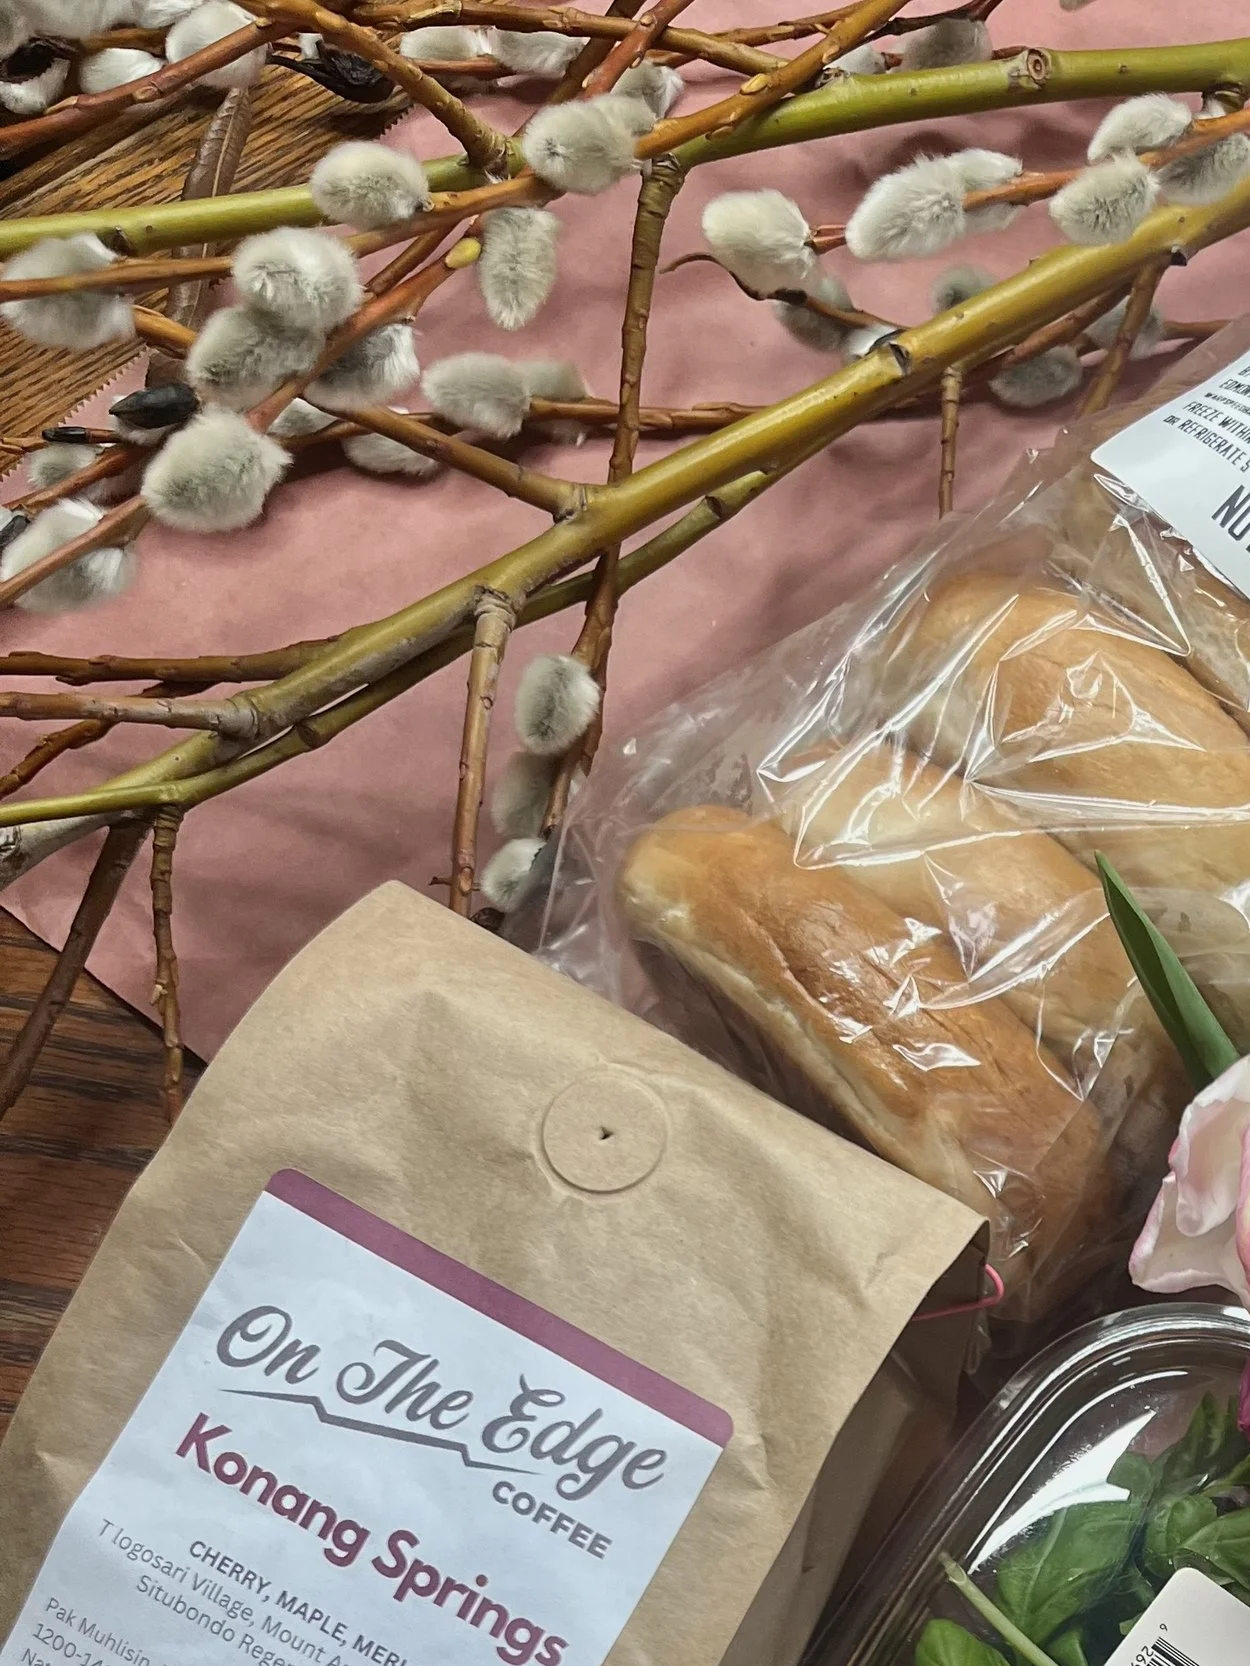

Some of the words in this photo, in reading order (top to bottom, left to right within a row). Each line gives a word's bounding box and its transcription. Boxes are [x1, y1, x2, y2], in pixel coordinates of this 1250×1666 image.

[1163, 414, 1179, 426] OR
[1177, 419, 1249, 465] REFRIGERATE
[1182, 401, 1222, 422] FREEZE
[217, 1305, 322, 1385] On
[336, 1339, 474, 1431] The
[482, 1374, 668, 1501] Edge
[175, 1412, 371, 1568] Konang
[492, 1481, 613, 1560] COFFEE
[46, 1597, 77, 1628] Pak
[136, 1575, 235, 1642] Situbondo
[189, 1541, 272, 1602] CHERRY,
[275, 1590, 348, 1647] MAPLE,
[192, 1572, 255, 1627] Village,
[261, 1615, 326, 1663] Mount
[1159, 1623, 1168, 1632] 6
